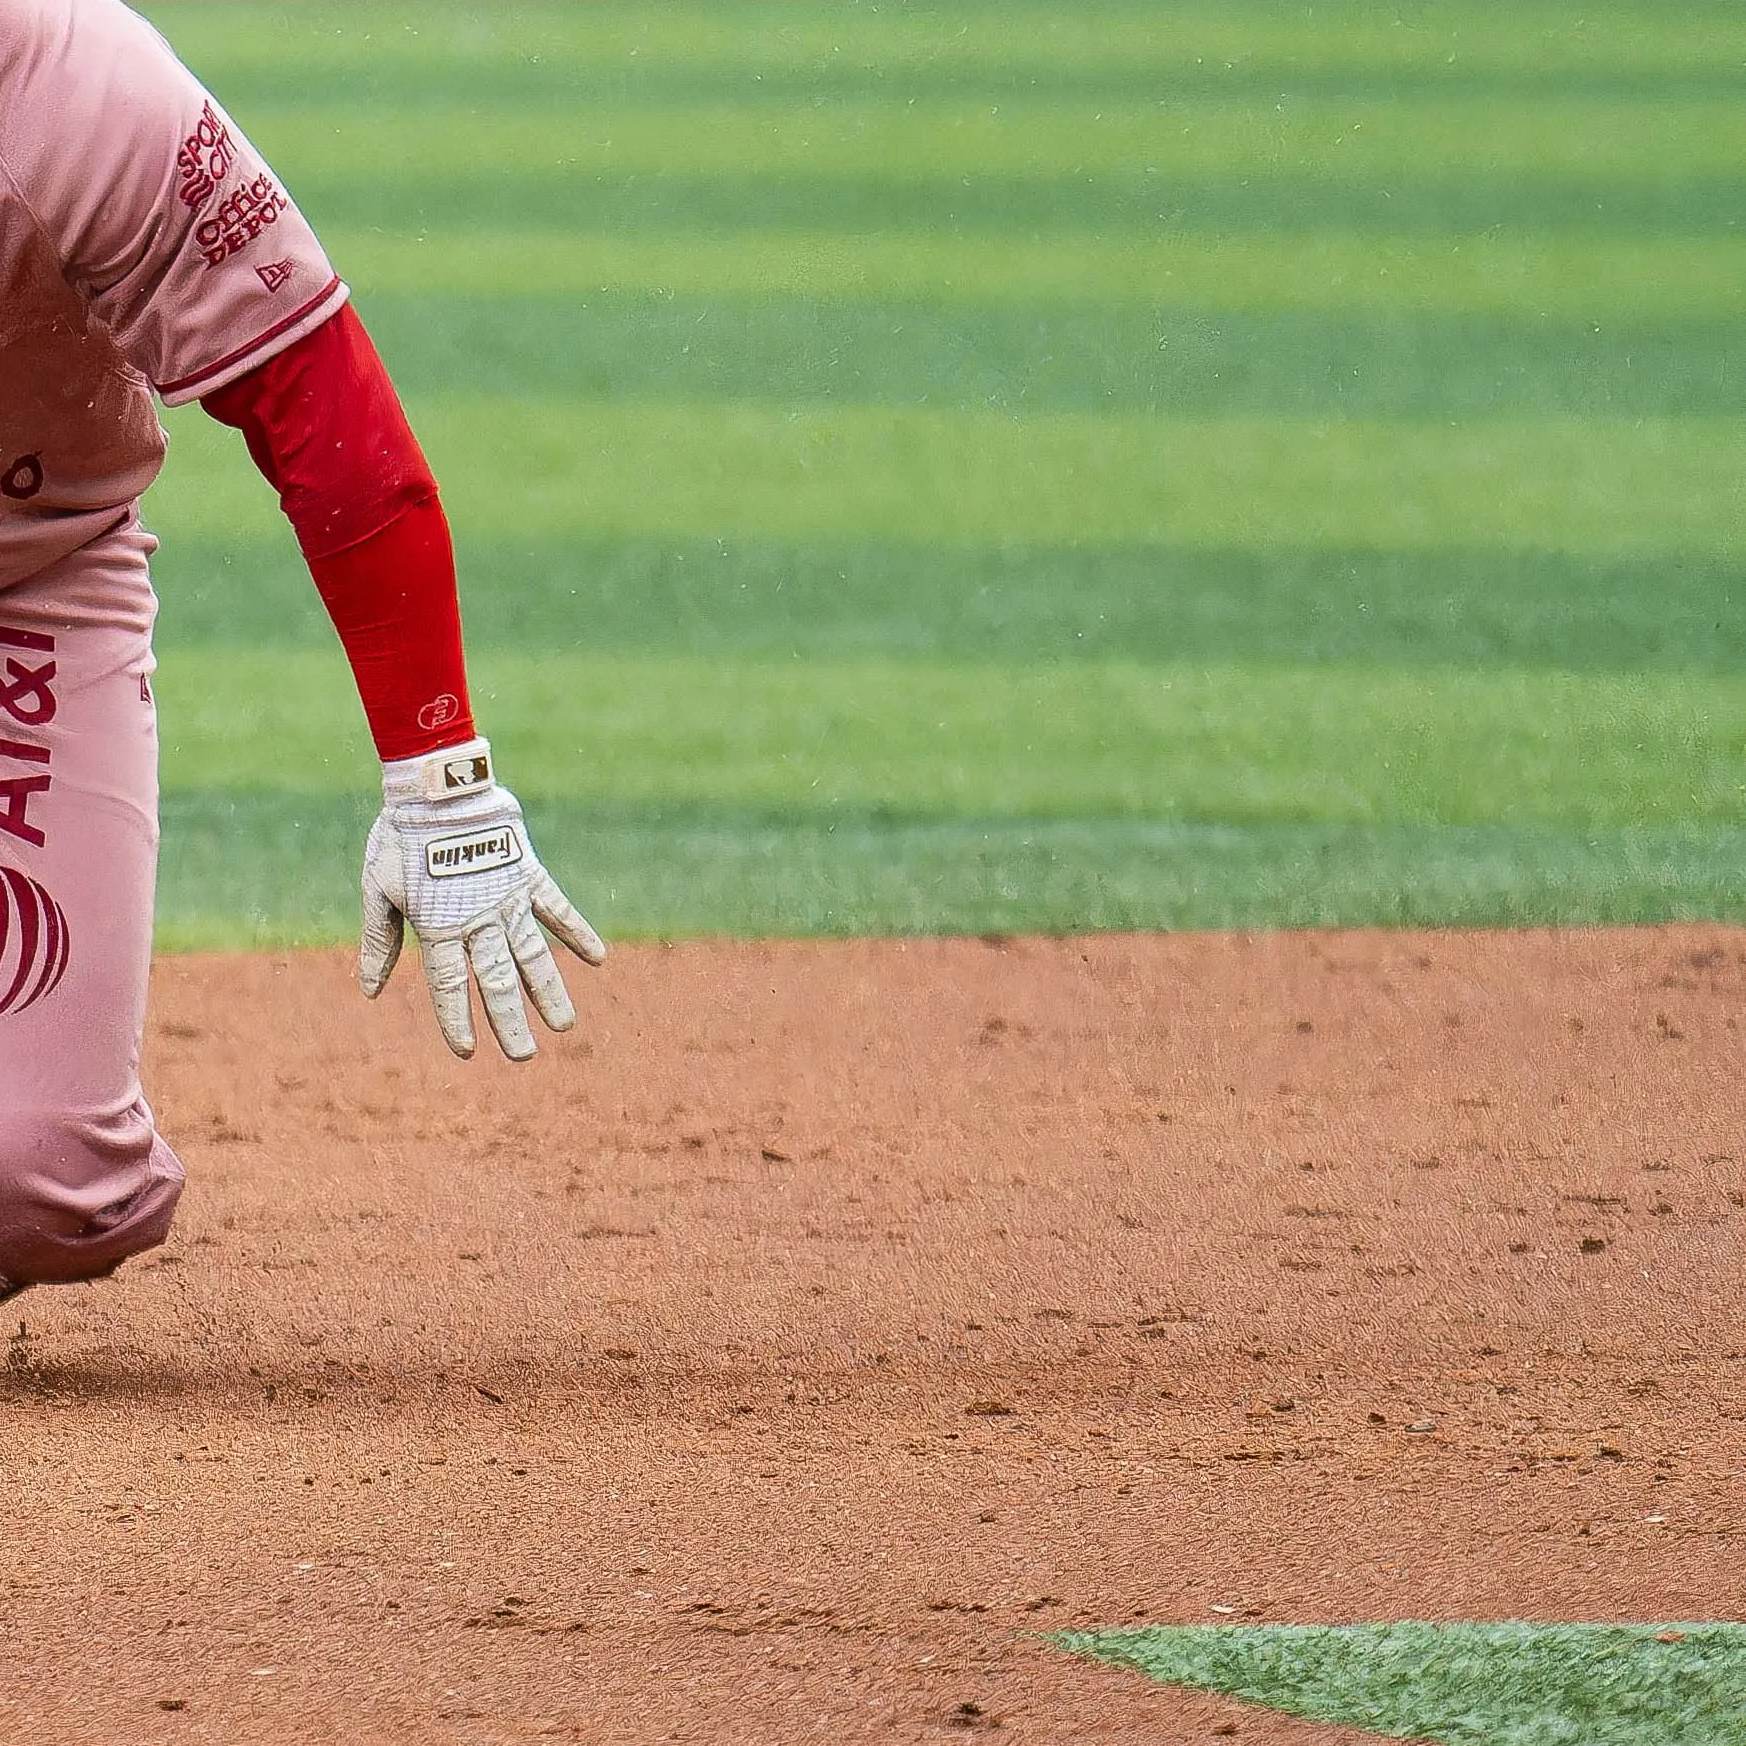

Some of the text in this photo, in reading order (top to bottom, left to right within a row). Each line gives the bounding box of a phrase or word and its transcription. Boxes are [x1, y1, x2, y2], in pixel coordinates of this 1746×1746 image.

[177, 99, 223, 180] SPORT
[203, 192, 288, 269] DEPOT
[432, 831, 512, 869] Franklin
